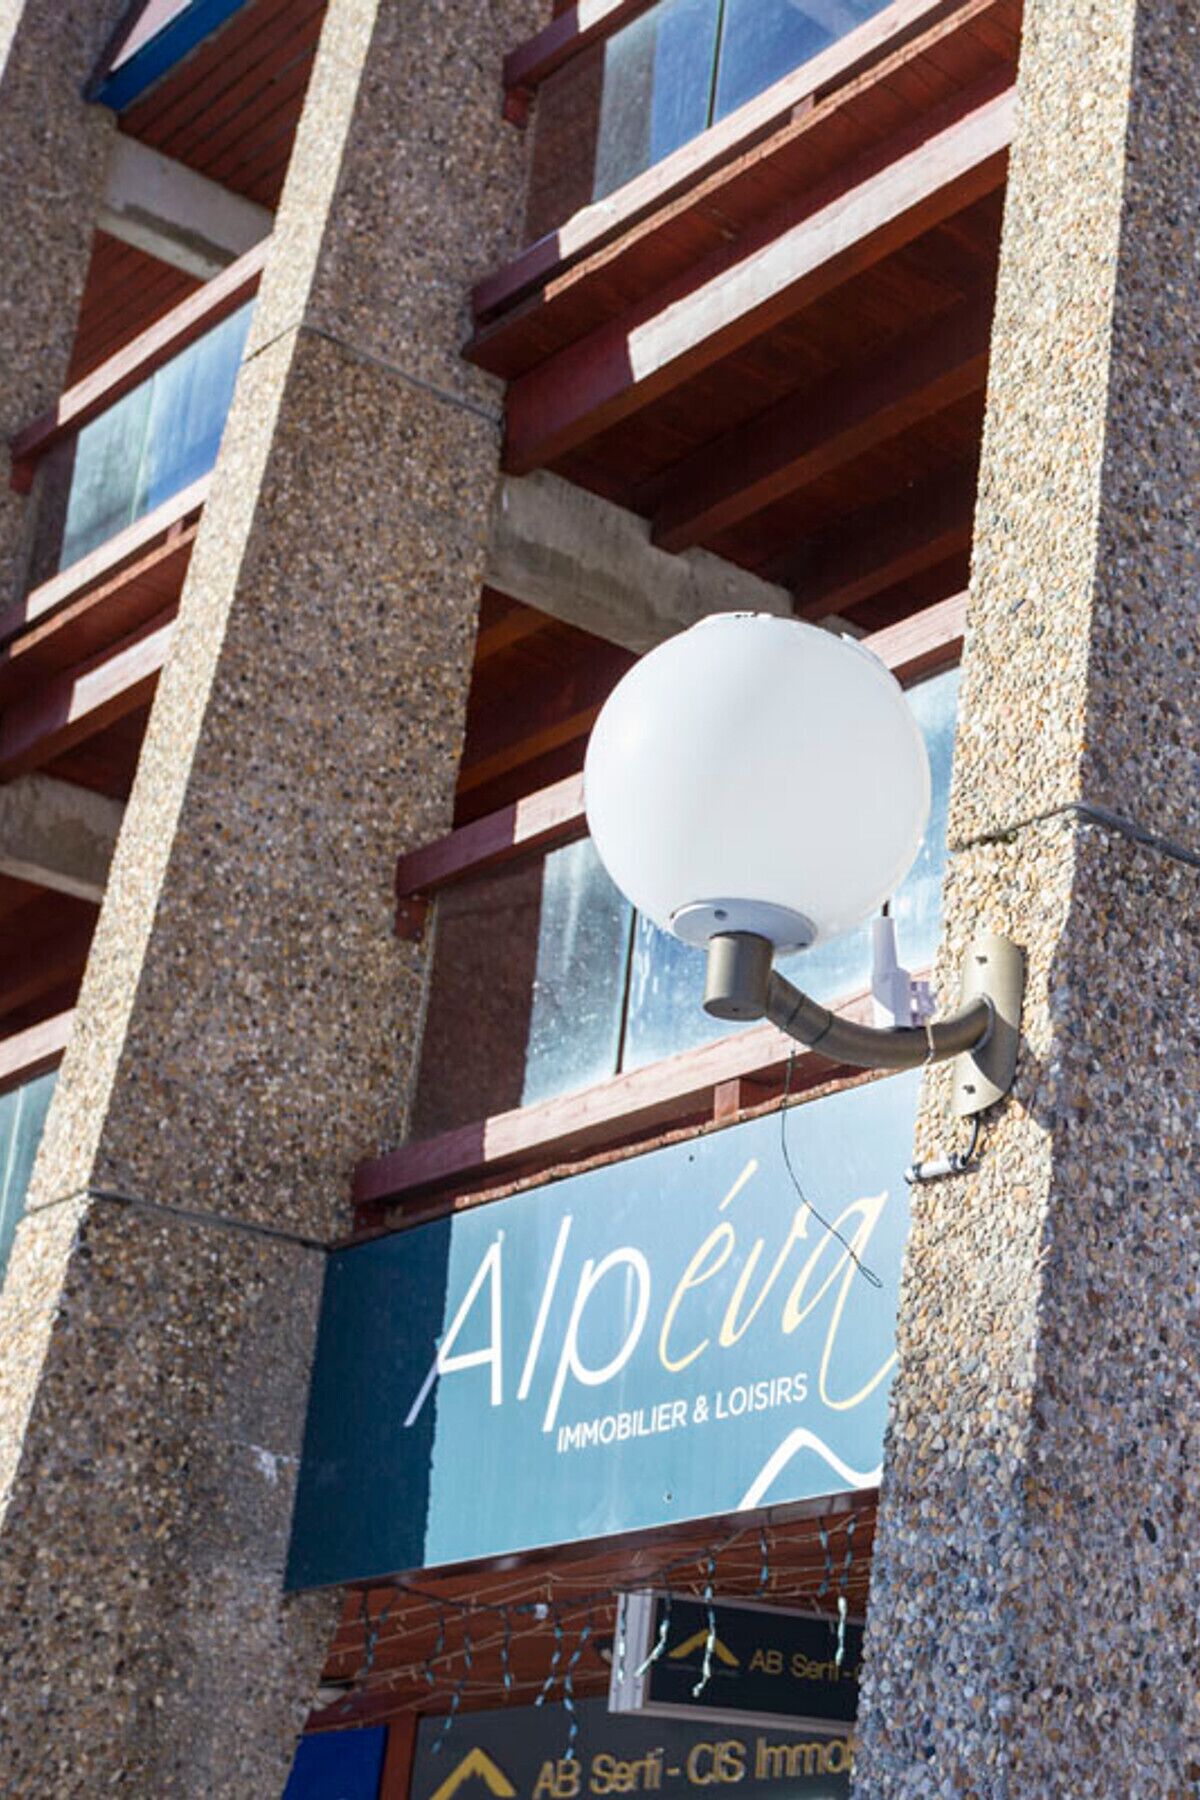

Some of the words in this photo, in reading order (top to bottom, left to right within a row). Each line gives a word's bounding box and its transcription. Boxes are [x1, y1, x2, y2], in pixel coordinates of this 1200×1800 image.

[557, 1400, 688, 1453] IMMOBILIER
[692, 1394, 709, 1424] &
[716, 1373, 809, 1420] LOISIRS
[748, 1648, 784, 1676] AB
[532, 1757, 581, 1800] AB
[687, 1740, 747, 1786] CIS
